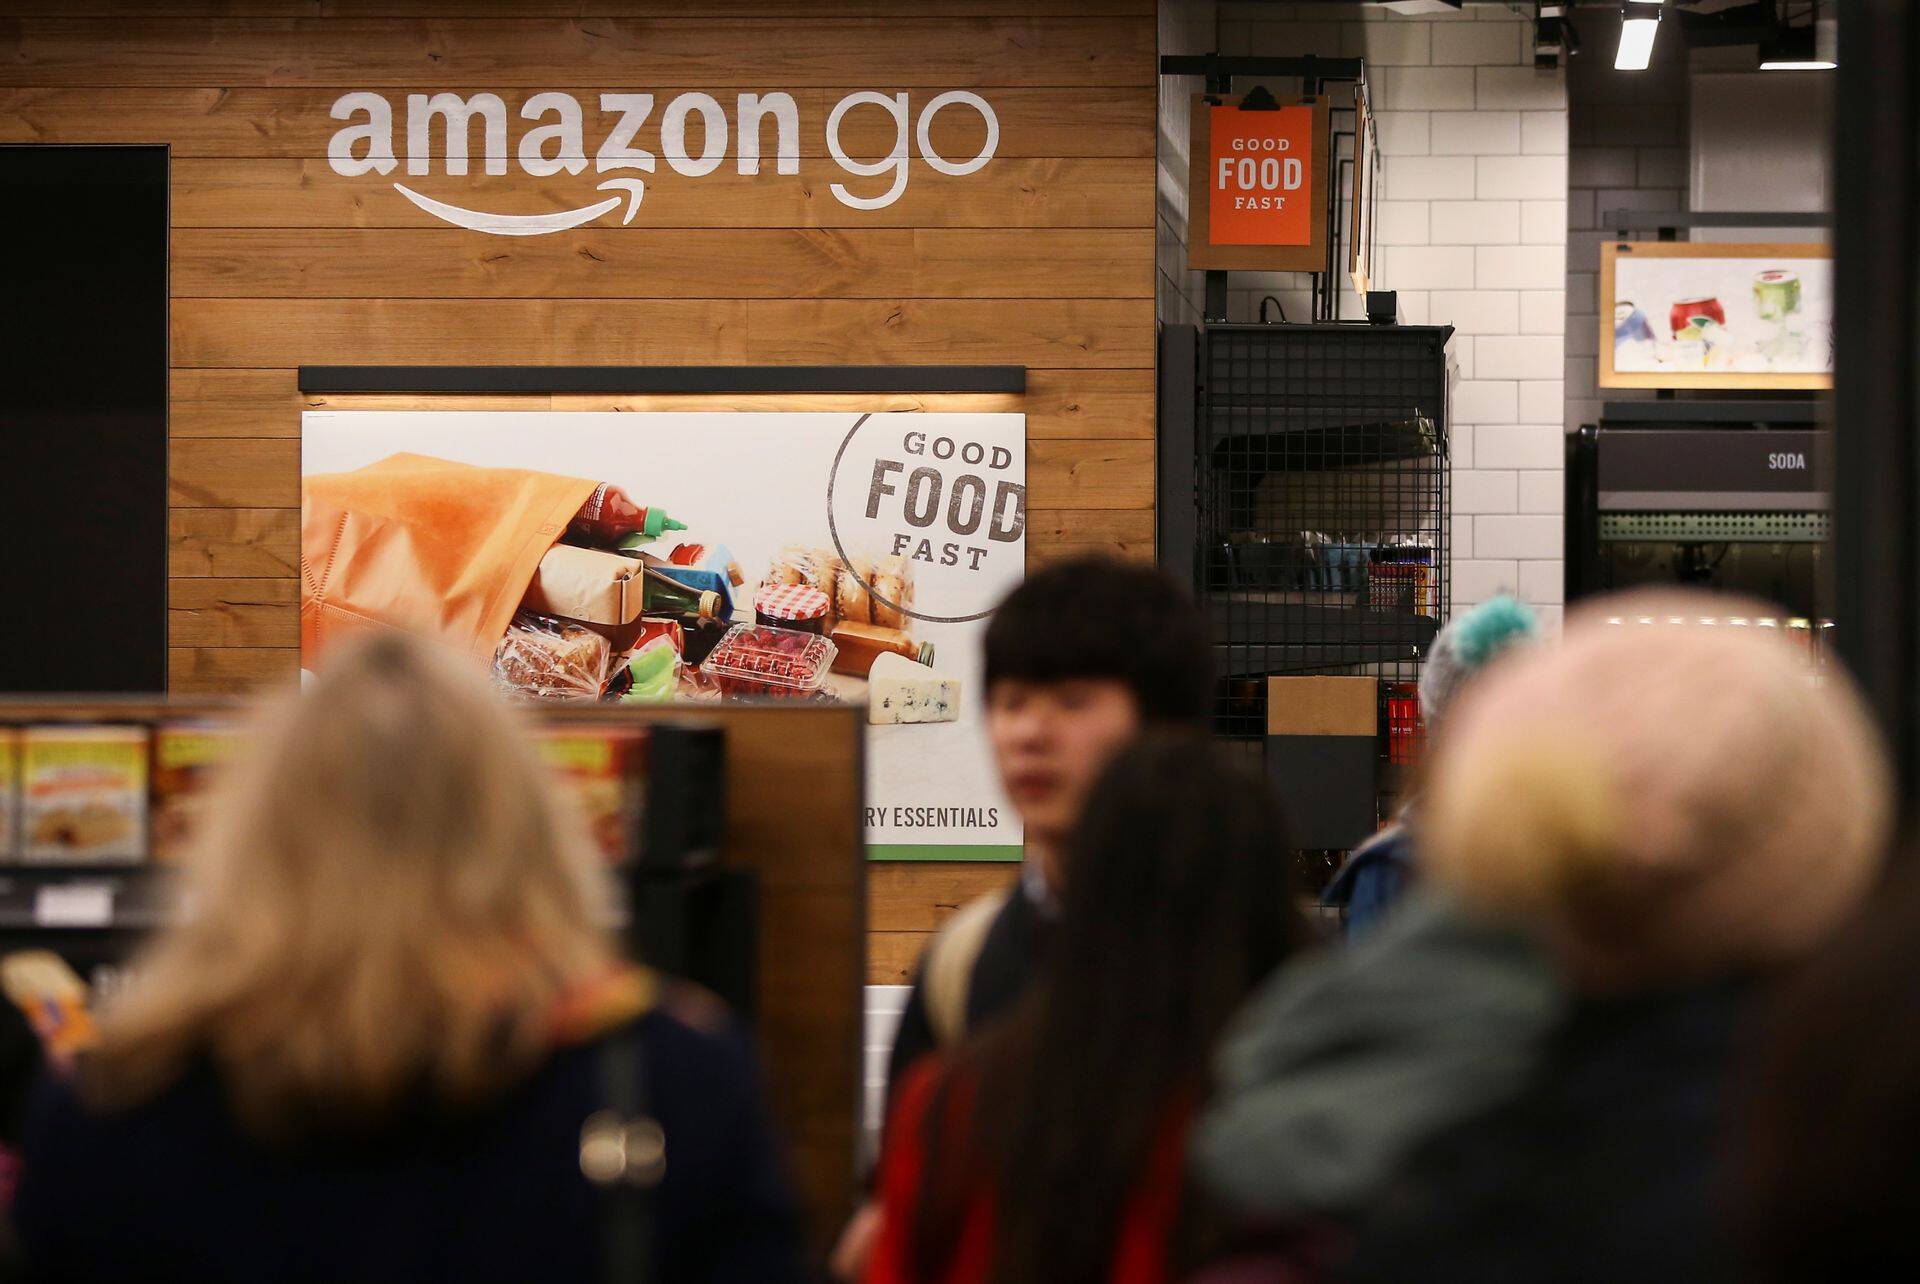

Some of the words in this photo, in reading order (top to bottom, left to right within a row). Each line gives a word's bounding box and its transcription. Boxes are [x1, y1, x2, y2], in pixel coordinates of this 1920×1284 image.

[327, 91, 800, 177] amazon
[825, 90, 1000, 211] go
[1231, 138, 1291, 151] GOOD
[1218, 157, 1303, 190] FOOD
[1234, 197, 1286, 210] FAST
[903, 431, 1012, 470] GOOD
[1768, 453, 1806, 469] SODA
[864, 458, 1025, 543] FOOD
[890, 533, 988, 571] FAST
[893, 807, 998, 828] ESSENTIALS
